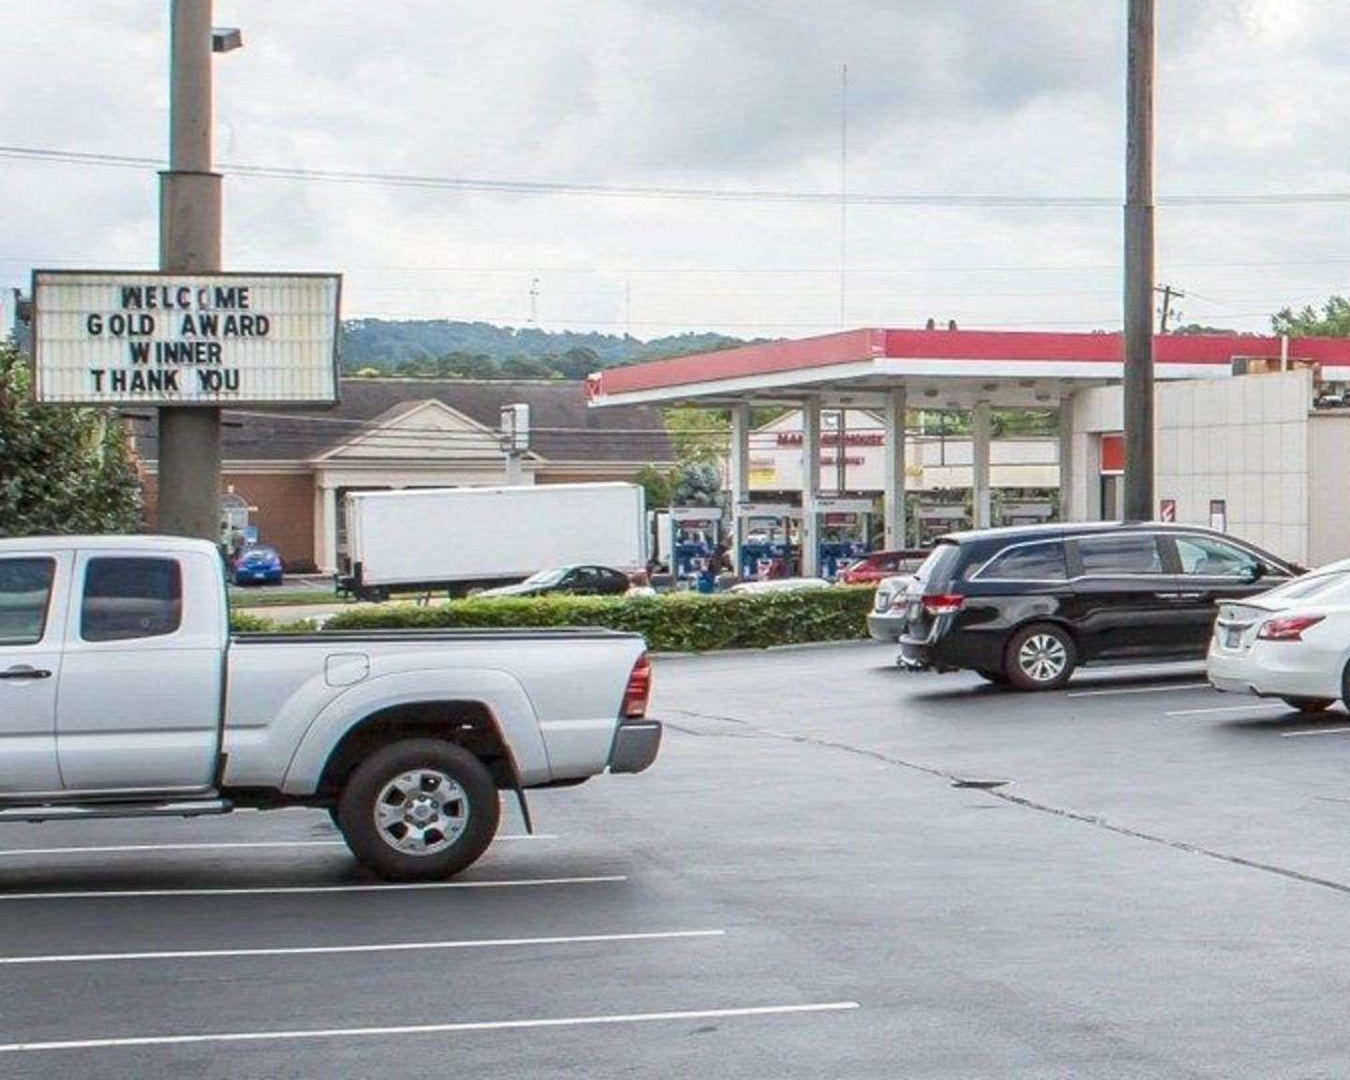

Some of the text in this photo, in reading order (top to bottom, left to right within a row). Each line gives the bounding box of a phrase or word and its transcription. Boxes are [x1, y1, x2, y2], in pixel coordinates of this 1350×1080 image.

[121, 285, 250, 309] WELCOME
[86, 314, 271, 337] GOLD AWARD
[129, 341, 223, 365] WINNER
[91, 369, 240, 392] THANK YOU
